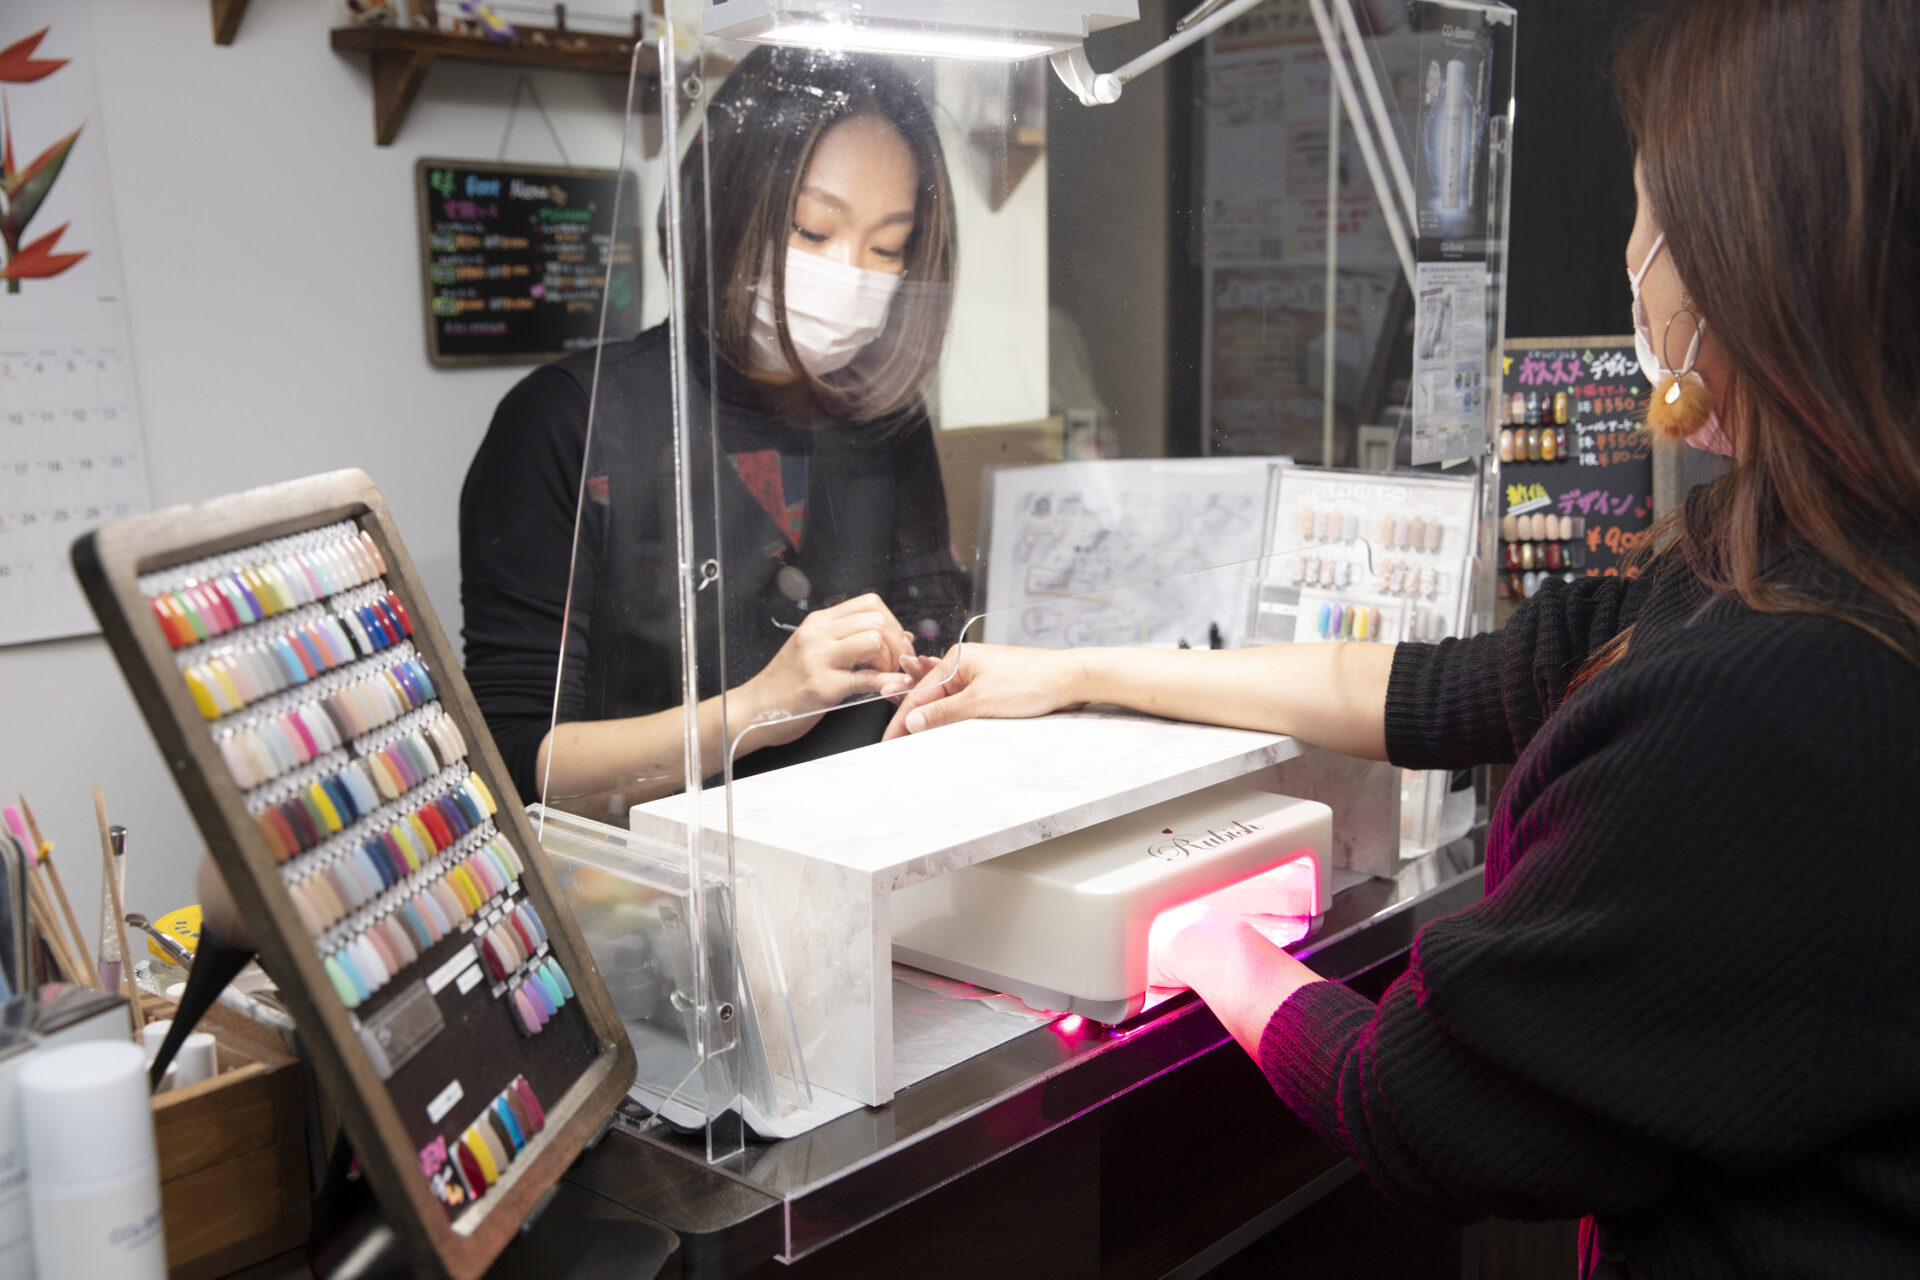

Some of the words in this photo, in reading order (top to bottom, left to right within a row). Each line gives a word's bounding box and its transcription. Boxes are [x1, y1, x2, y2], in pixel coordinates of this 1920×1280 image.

[1519, 356, 1584, 386] オススメ
[1590, 351, 1640, 380] デザイン
[1557, 489, 1634, 515] デザイン
